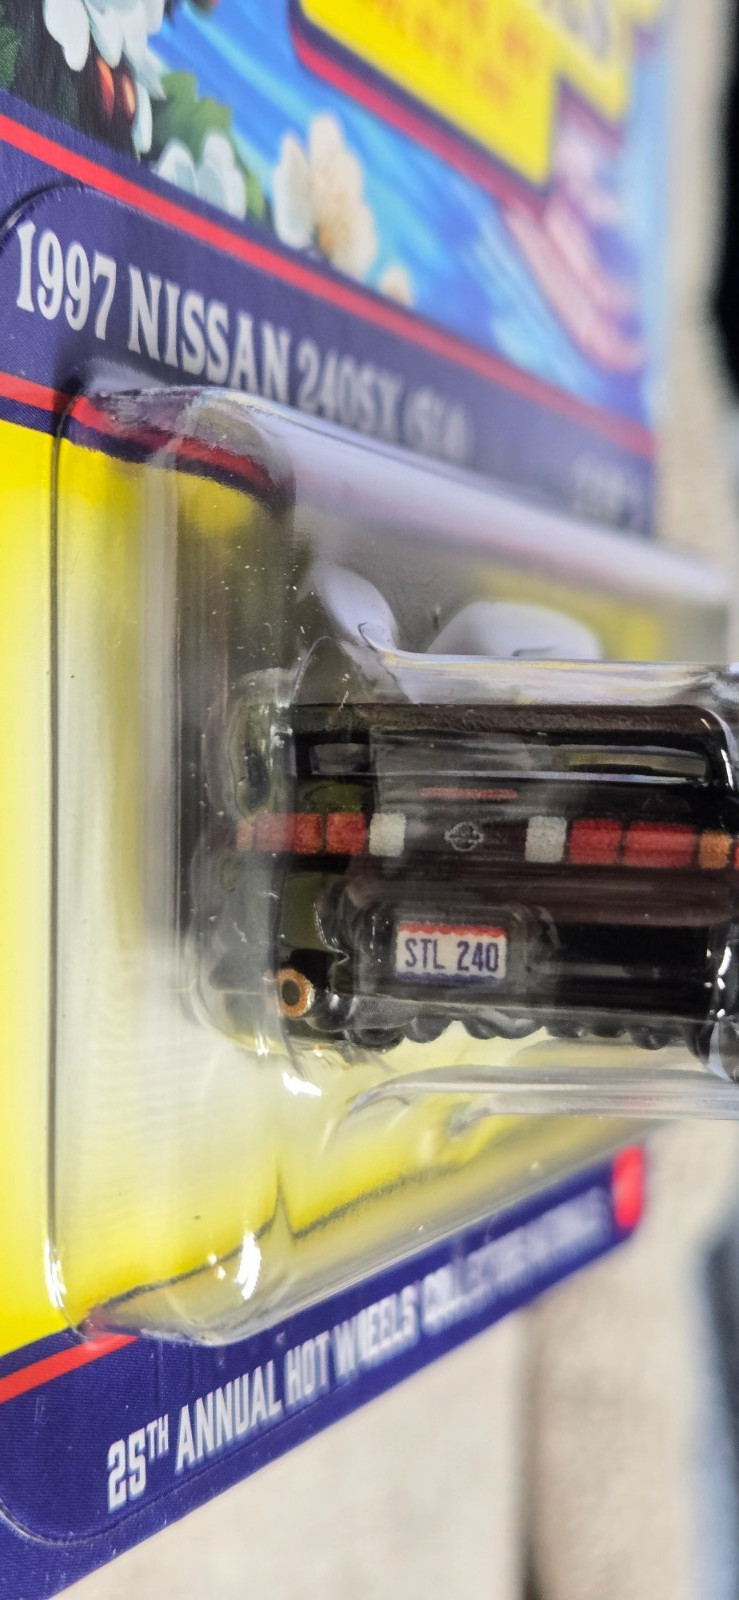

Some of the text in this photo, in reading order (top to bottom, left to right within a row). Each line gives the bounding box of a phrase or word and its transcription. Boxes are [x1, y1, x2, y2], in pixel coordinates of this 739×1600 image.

[16, 219, 117, 342] 1997
[127, 263, 291, 408] NISSAN
[405, 937, 500, 973] STL 240
[174, 1358, 282, 1474] ANNUAL
[285, 1328, 331, 1406] HOT
